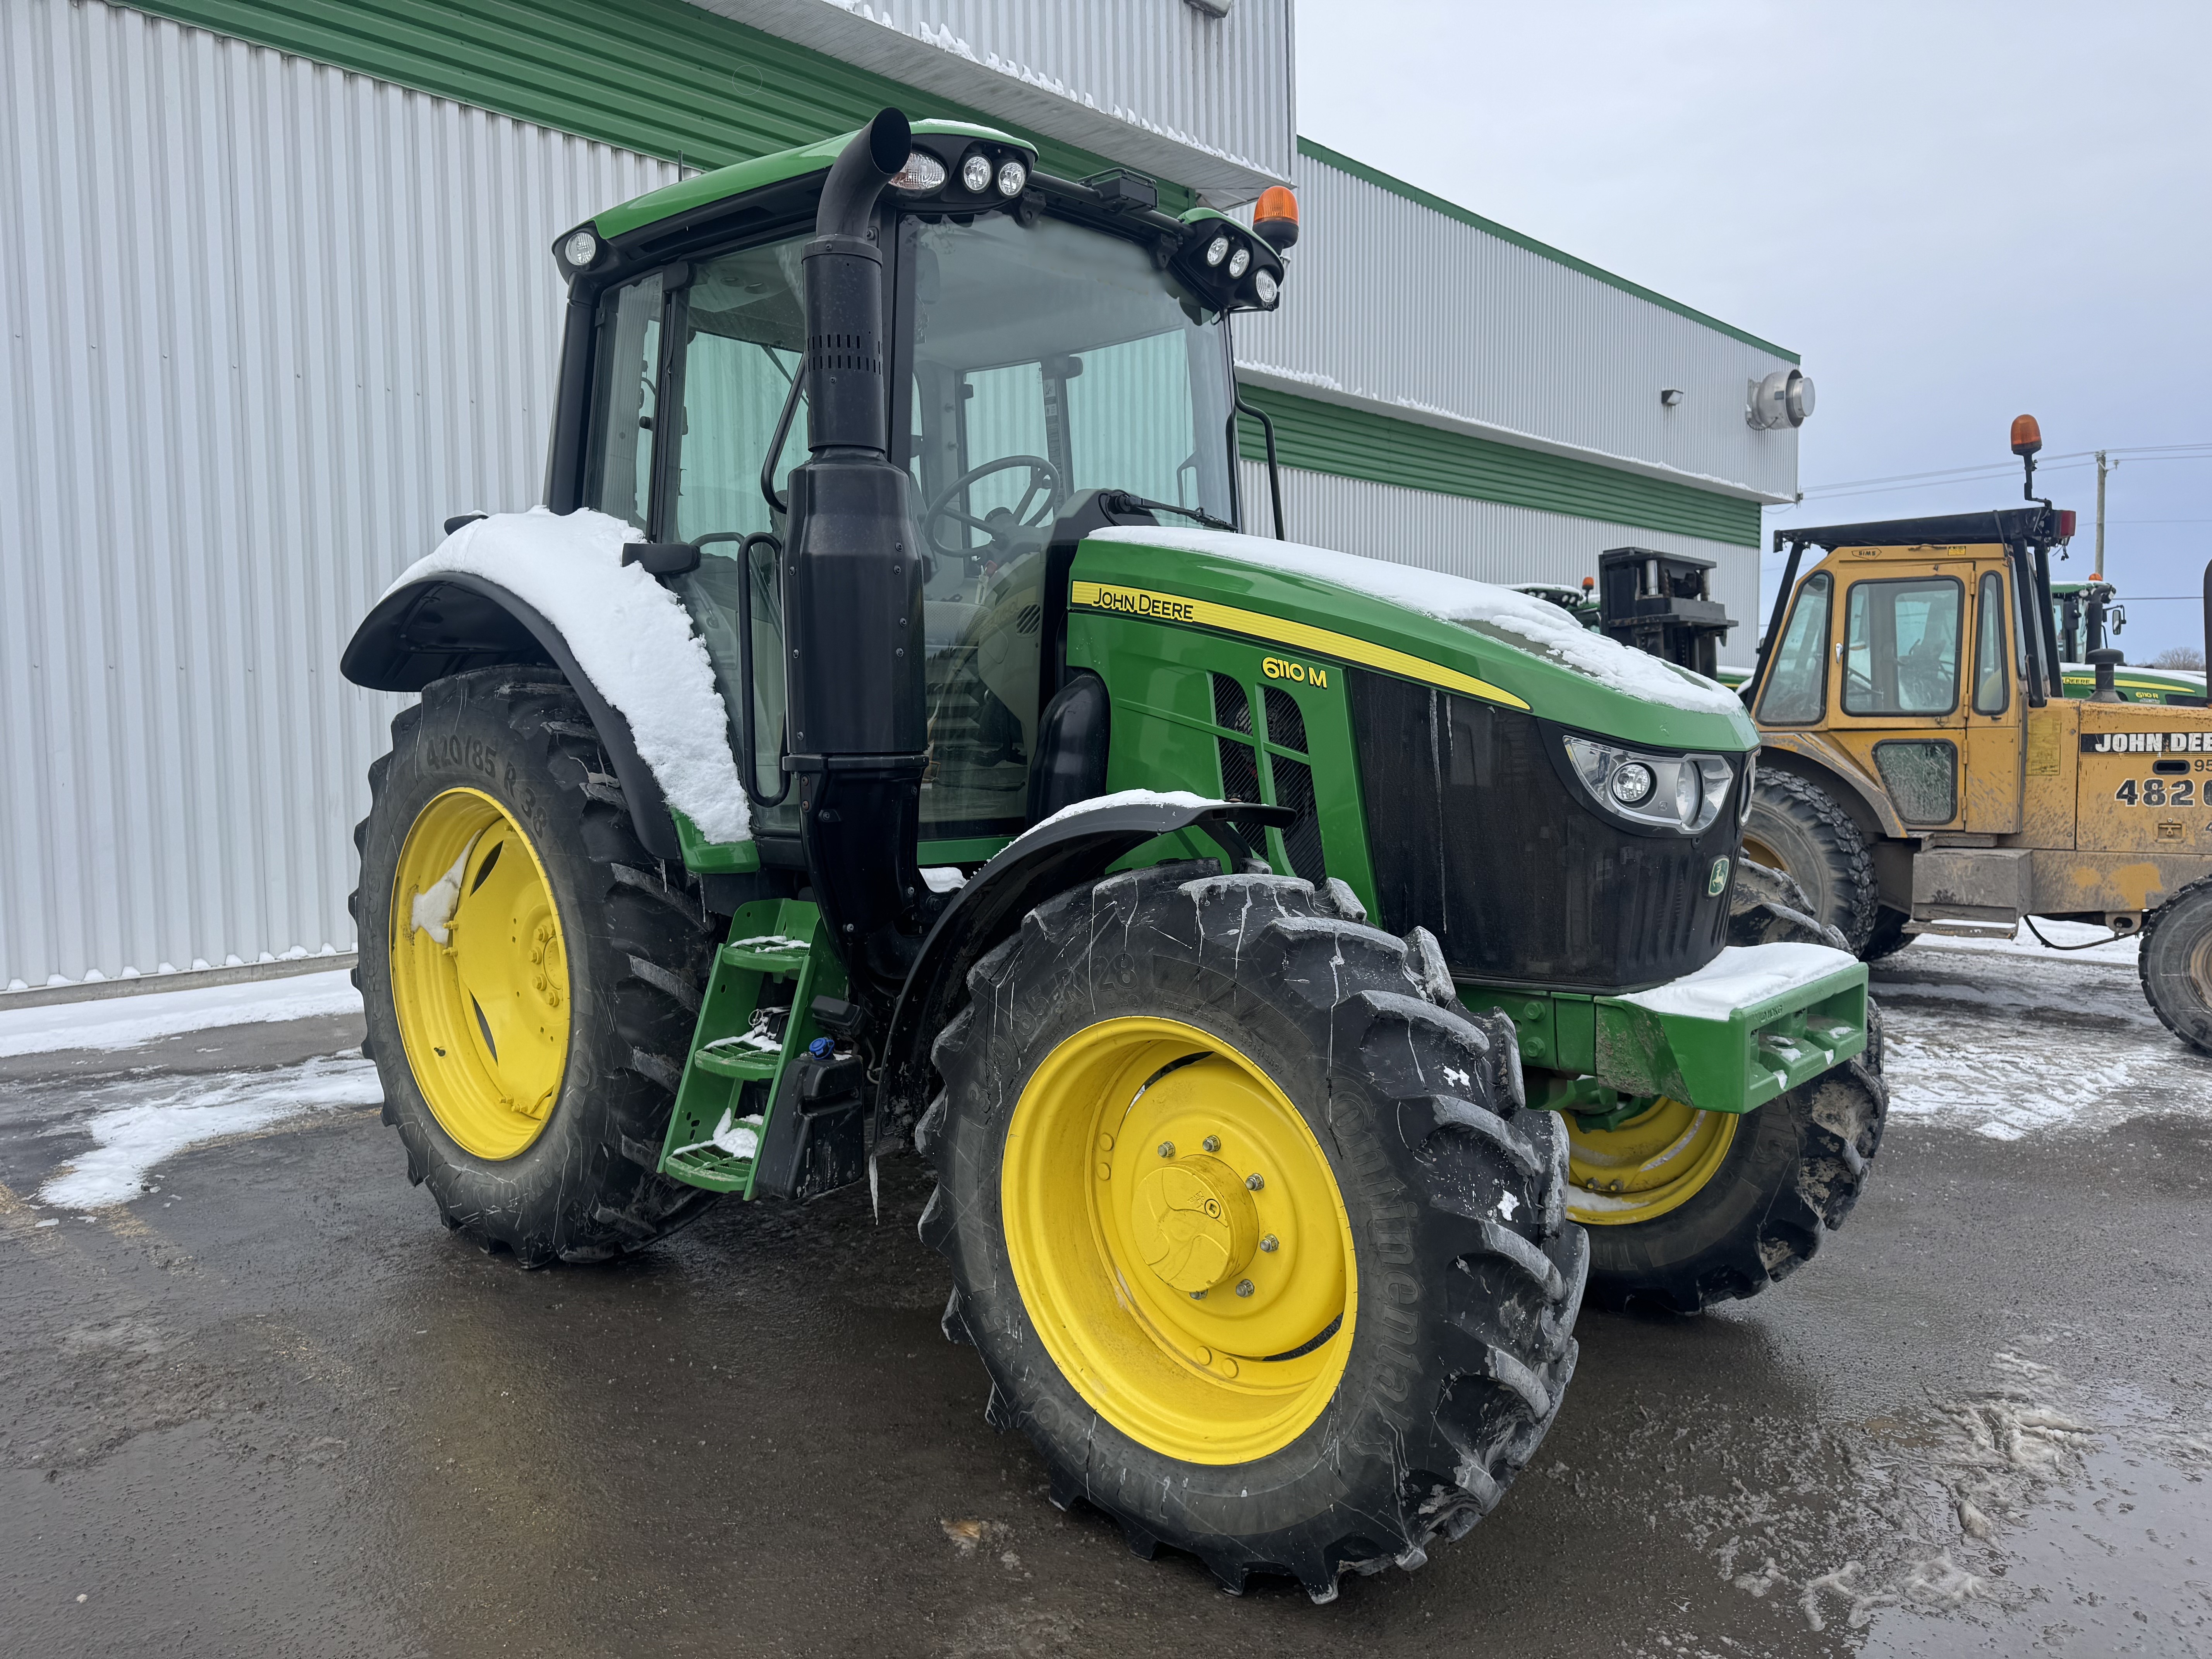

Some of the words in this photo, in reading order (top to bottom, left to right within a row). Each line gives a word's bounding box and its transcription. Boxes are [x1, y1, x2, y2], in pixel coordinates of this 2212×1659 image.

[1093, 587, 1135, 611] JOHN
[1139, 594, 1194, 620] DEERE
[1262, 656, 1305, 682] 6110
[1308, 666, 1328, 689] M
[2095, 733, 2162, 752] JOHN
[426, 735, 496, 778] 420/85
[505, 760, 517, 799] R
[521, 787, 548, 839] 38
[1054, 966, 1085, 1005] R
[1095, 953, 1138, 993] 28
[1164, 1000, 1214, 1023] ENGINEERED
[1219, 1020, 1234, 1035] FOR
[1240, 1035, 1283, 1073] EFFICIENCY
[1316, 1077, 1423, 1431] Continental
